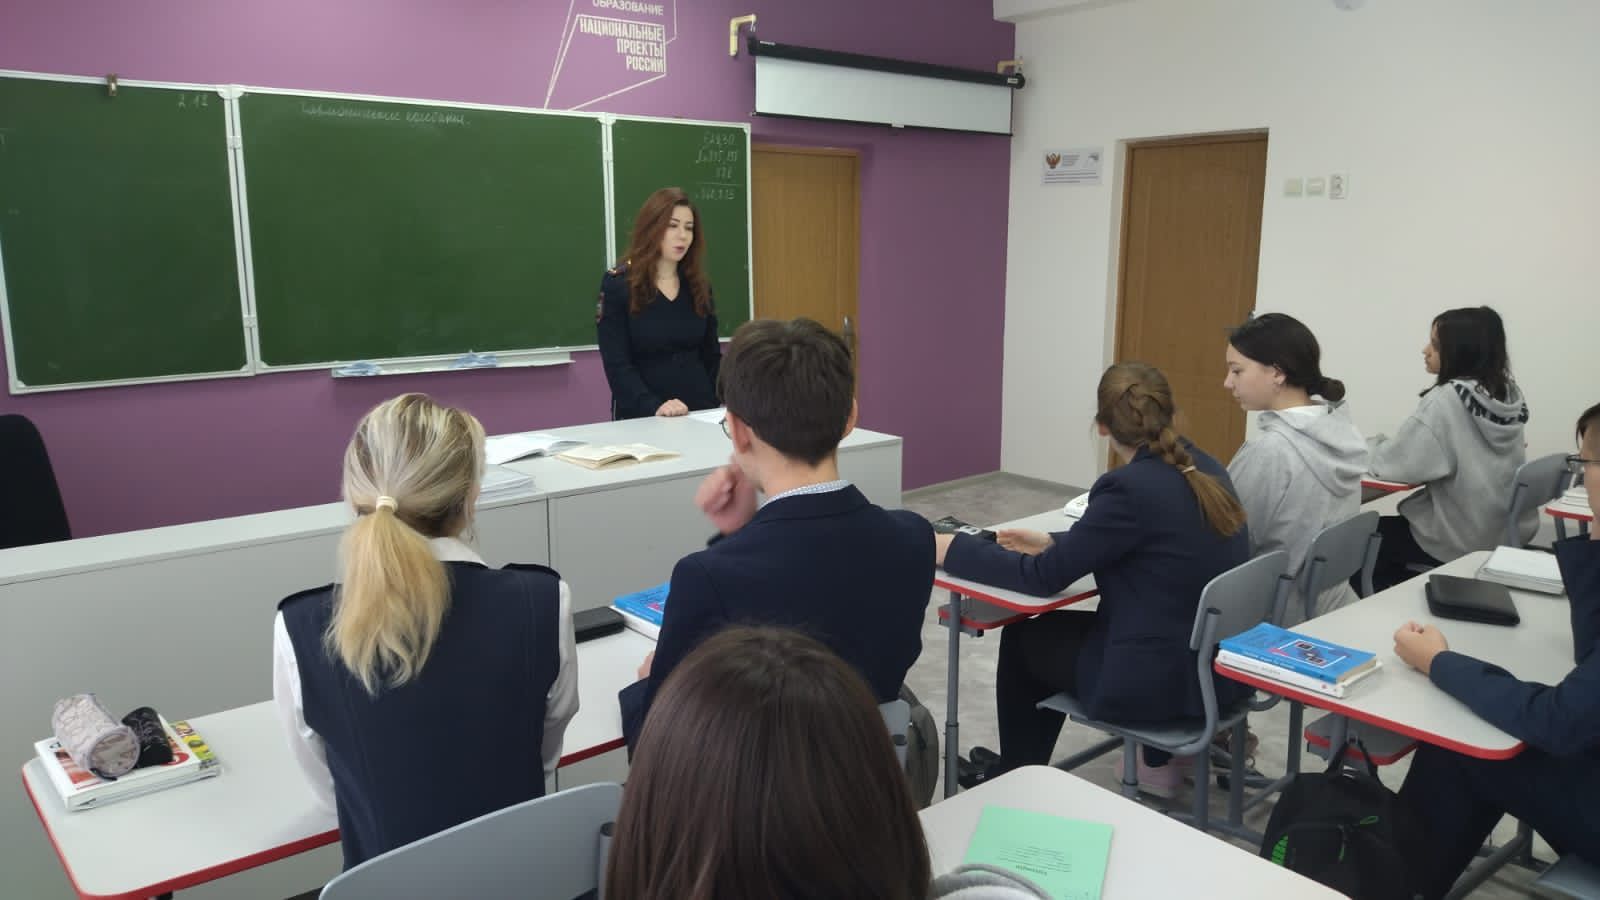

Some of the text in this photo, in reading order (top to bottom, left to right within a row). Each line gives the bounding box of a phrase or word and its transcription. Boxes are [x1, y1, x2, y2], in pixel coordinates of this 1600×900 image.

[592, 0, 665, 16] ОБРАЗОВАНИЕ
[580, 17, 663, 41] НАЦИОНАЛЬНЫЕ
[616, 38, 663, 57] ПРОЕКТЫ
[626, 55, 664, 73] РОССИИ
